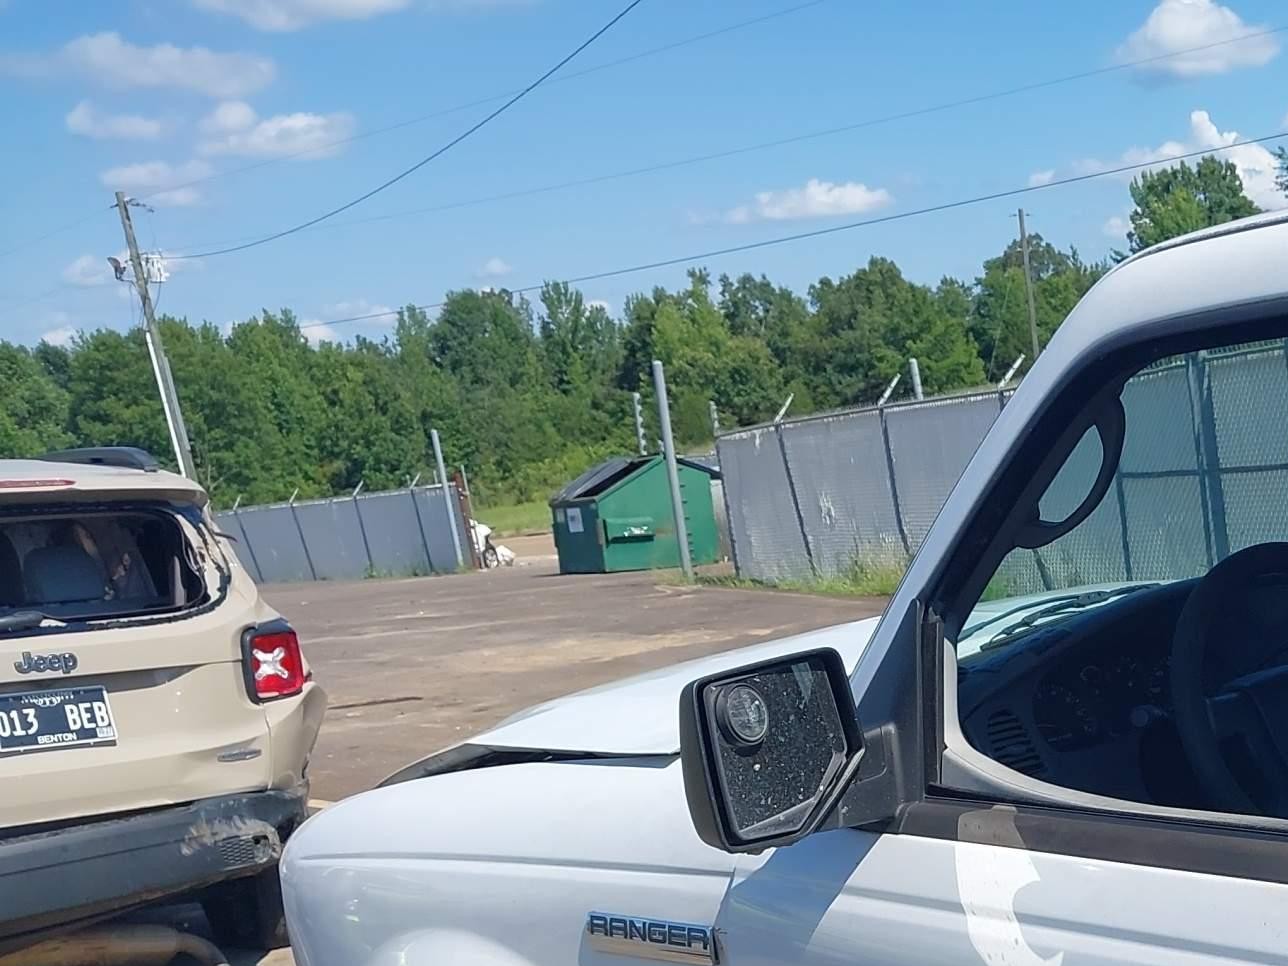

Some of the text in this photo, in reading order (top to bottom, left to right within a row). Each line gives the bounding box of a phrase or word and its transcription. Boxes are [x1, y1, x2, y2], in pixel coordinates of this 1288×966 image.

[14, 651, 78, 674] Jeep
[64, 701, 110, 731] BEB
[37, 732, 77, 744] BENTON
[590, 914, 711, 950] RANGER
